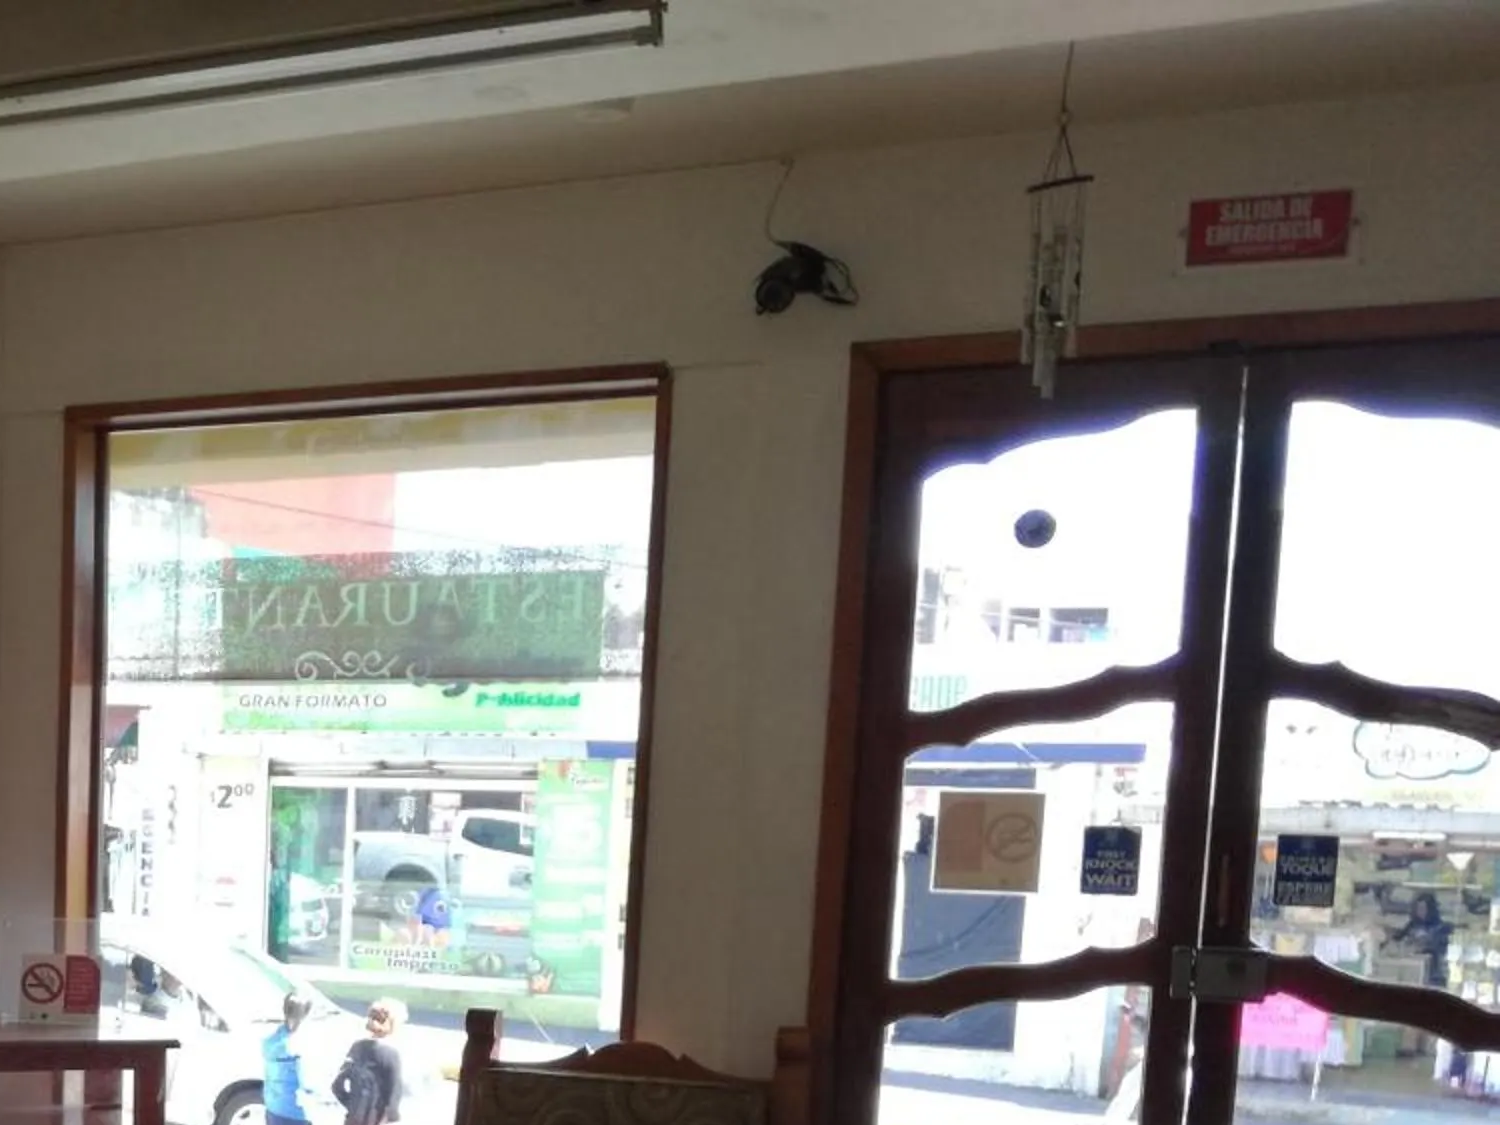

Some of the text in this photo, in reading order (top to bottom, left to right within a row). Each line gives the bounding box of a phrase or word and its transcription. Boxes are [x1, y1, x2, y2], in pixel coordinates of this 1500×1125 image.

[1219, 197, 1285, 222] SALIDA
[1205, 218, 1323, 246] EMERGENCIA
[239, 694, 388, 708] GRAN FORMATO
[1086, 873, 1135, 887] WAIT
